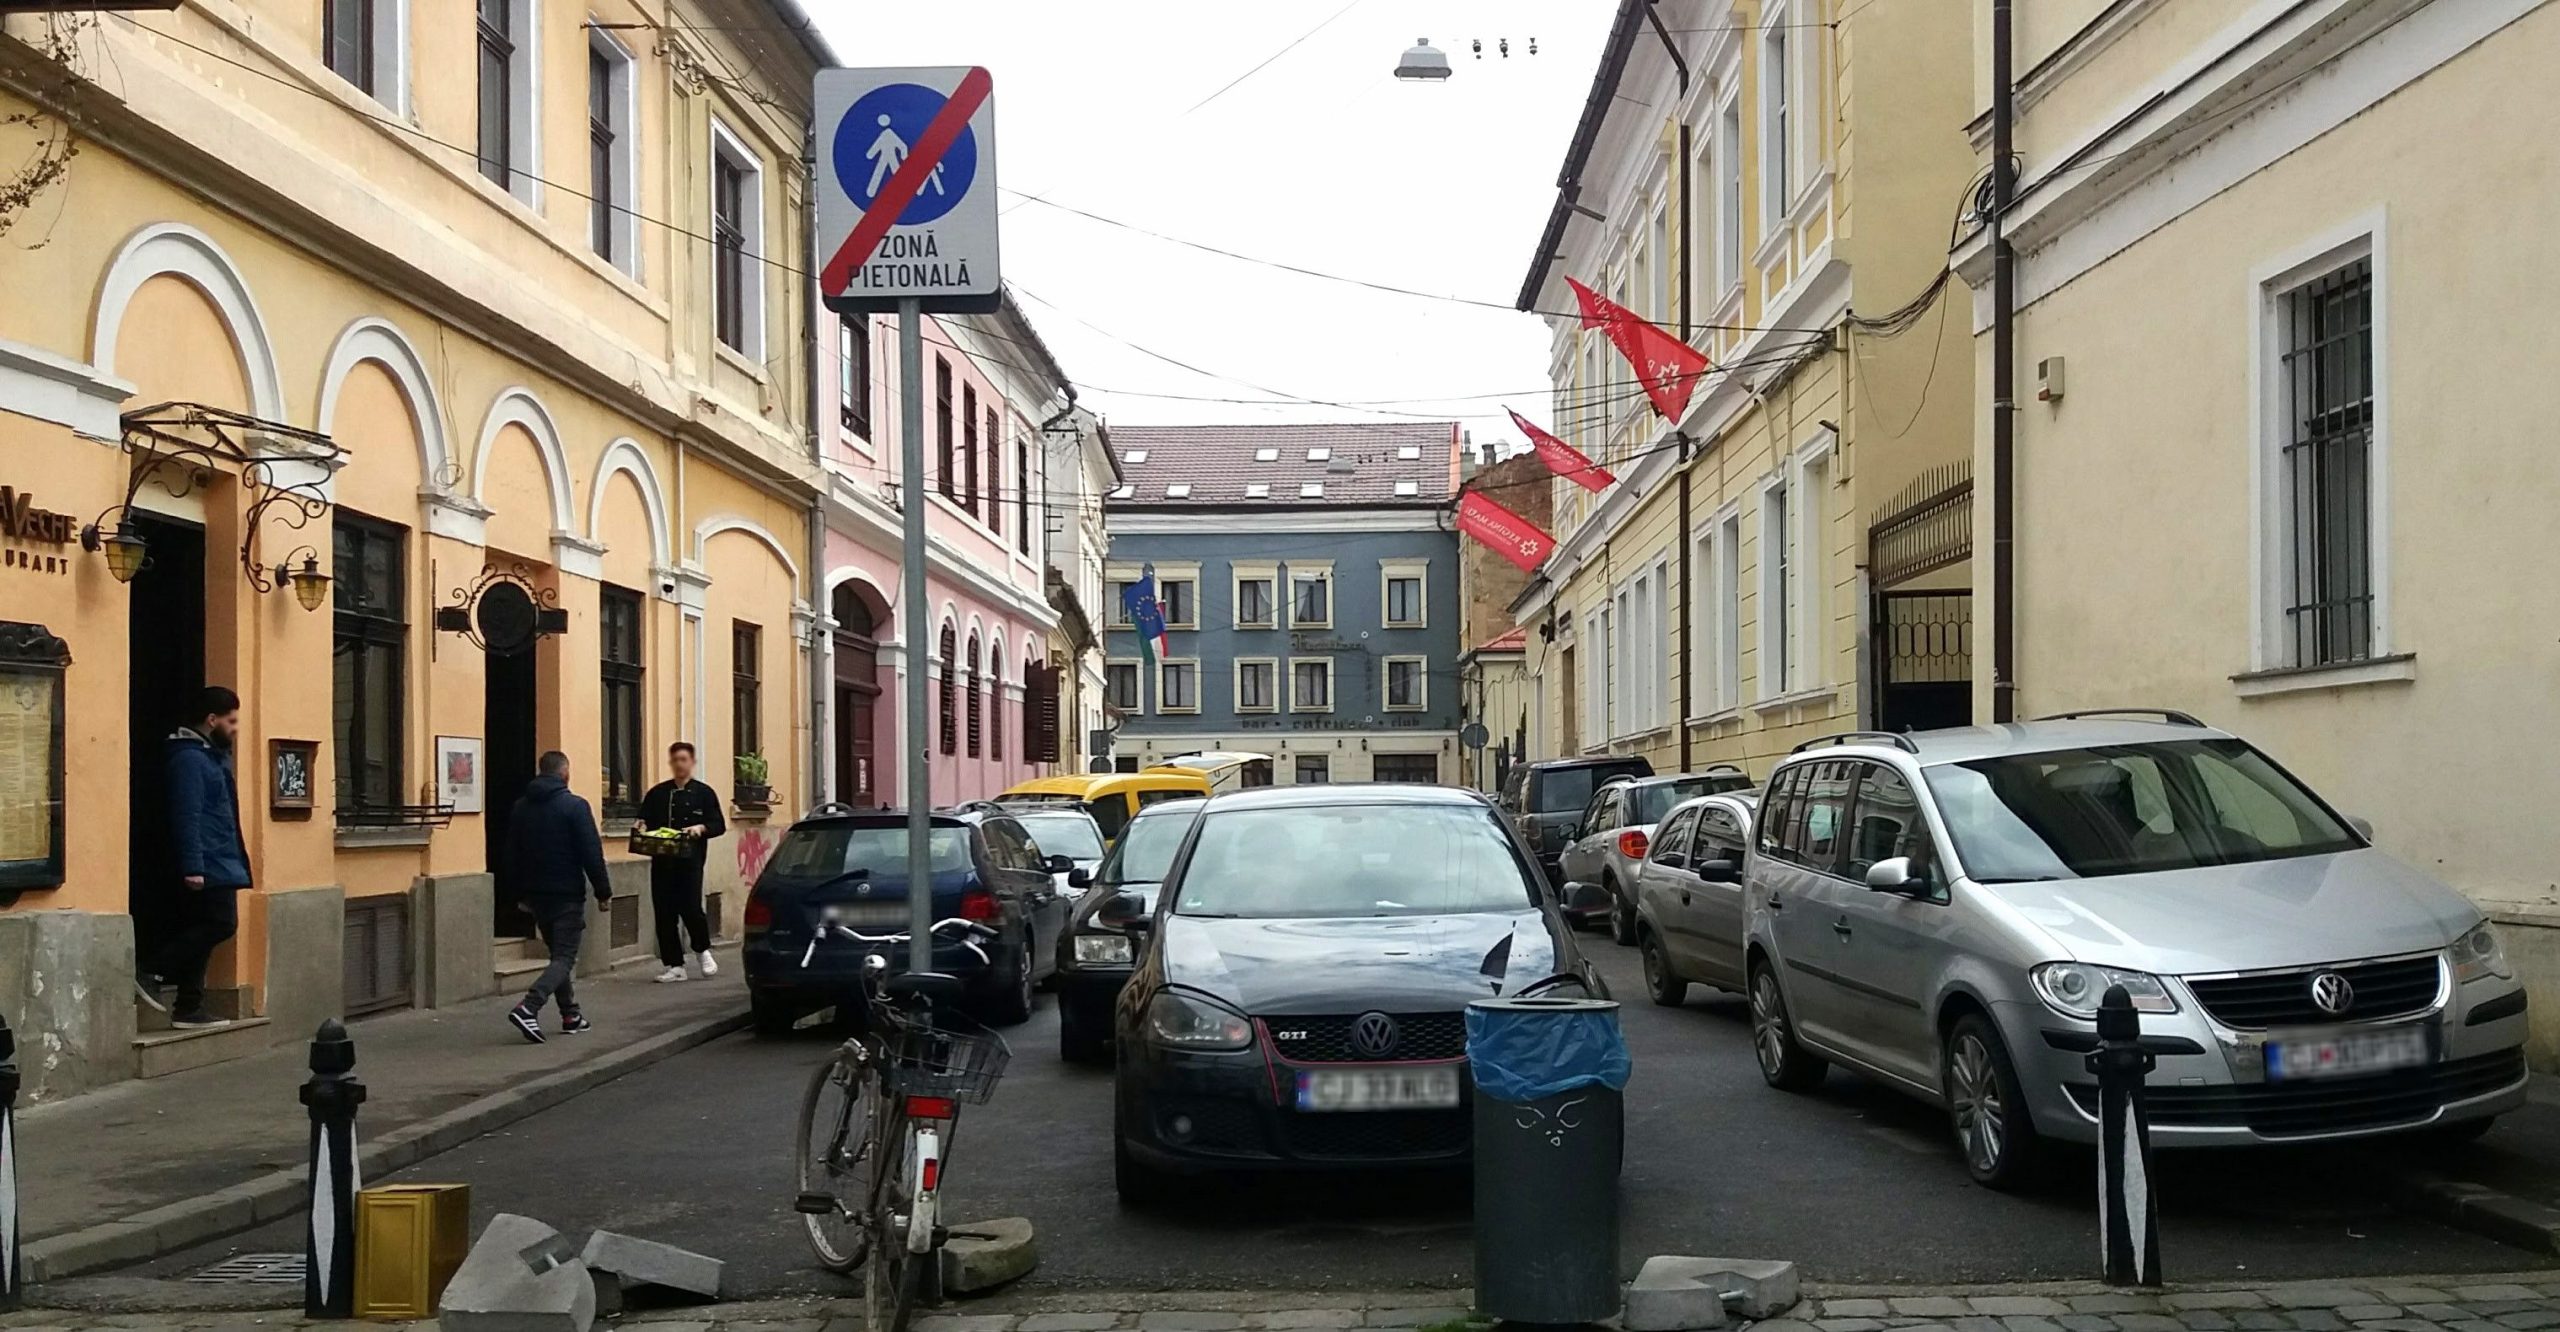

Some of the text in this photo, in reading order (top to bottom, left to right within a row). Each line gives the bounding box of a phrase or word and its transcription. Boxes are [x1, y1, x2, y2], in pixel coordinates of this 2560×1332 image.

[879, 230, 938, 259] ZONĂ
[848, 259, 971, 289] PIETONALĂ
[0, 549, 68, 576] URANT
[1279, 1031, 1308, 1040] GTI
